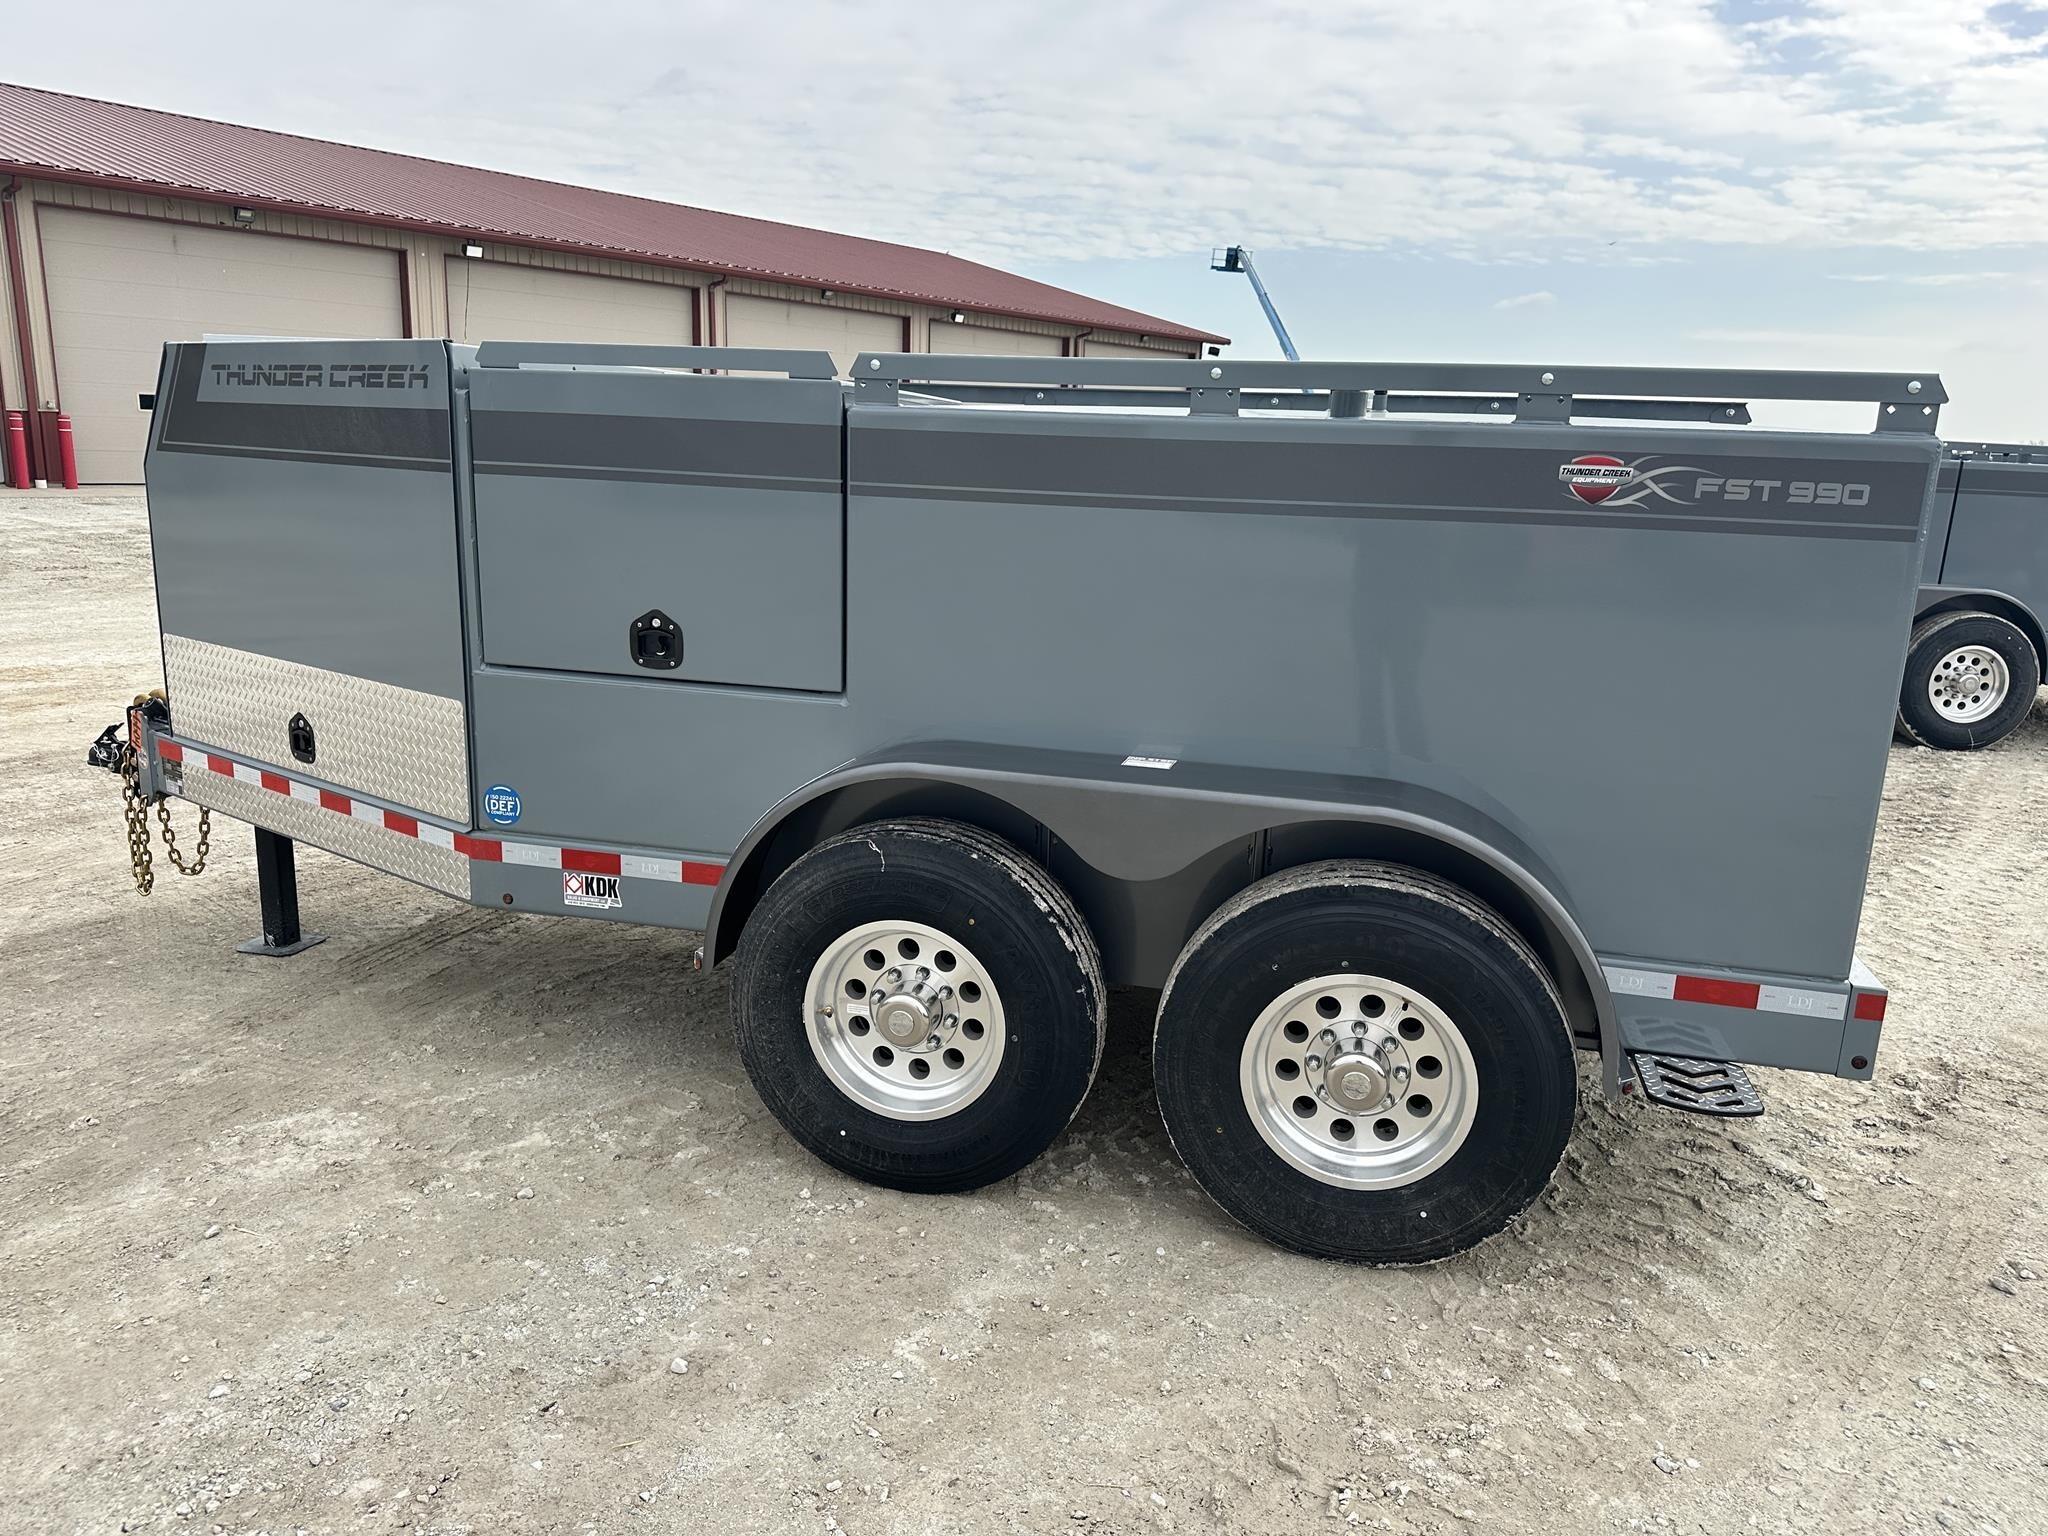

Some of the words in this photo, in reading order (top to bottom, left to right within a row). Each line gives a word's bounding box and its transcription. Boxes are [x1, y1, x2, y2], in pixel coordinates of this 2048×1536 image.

[211, 364, 323, 387] THUNDER
[329, 364, 430, 389] CREEK
[1561, 467, 1602, 476] THUNDER
[1602, 469, 1632, 478] CREEK
[1694, 477, 1783, 502] FST
[1786, 481, 1871, 506] 990
[490, 799, 515, 812] DEF
[584, 874, 619, 899] KDK
